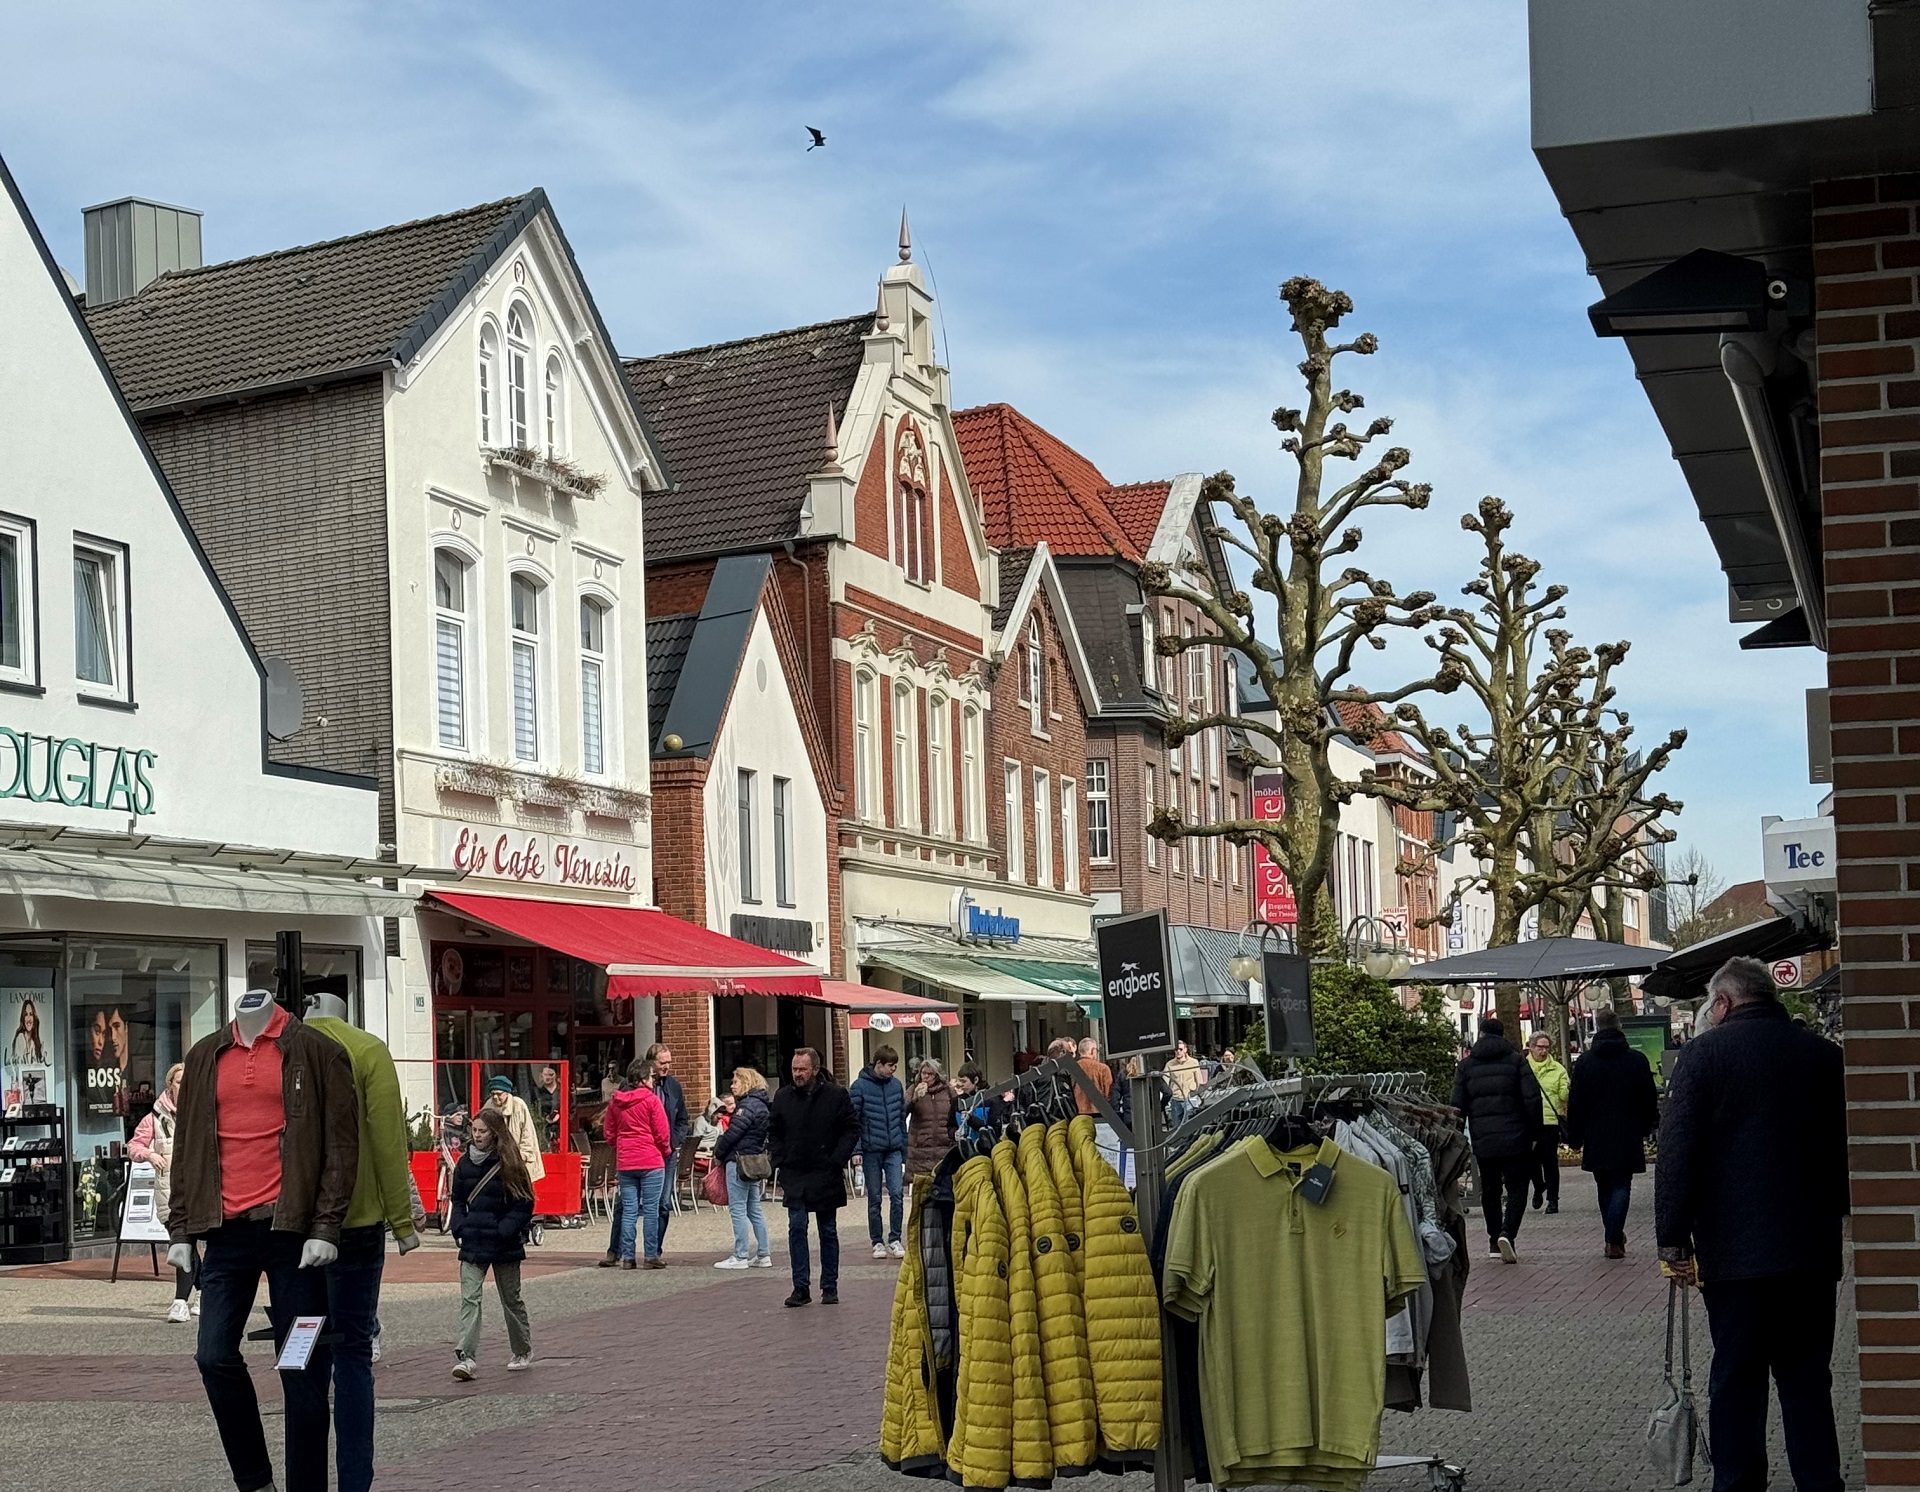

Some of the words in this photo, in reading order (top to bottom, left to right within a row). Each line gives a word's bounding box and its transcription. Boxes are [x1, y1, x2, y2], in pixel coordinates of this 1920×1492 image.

[1254, 786, 1282, 797] möbel
[453, 827, 488, 873] Eis
[494, 833, 545, 881] Cafe
[554, 844, 636, 891] Venezia
[1784, 843, 1825, 869] Tee
[1108, 971, 1161, 999] engbers
[1271, 995, 1308, 1014] engbers
[87, 1067, 121, 1088] BOSS
